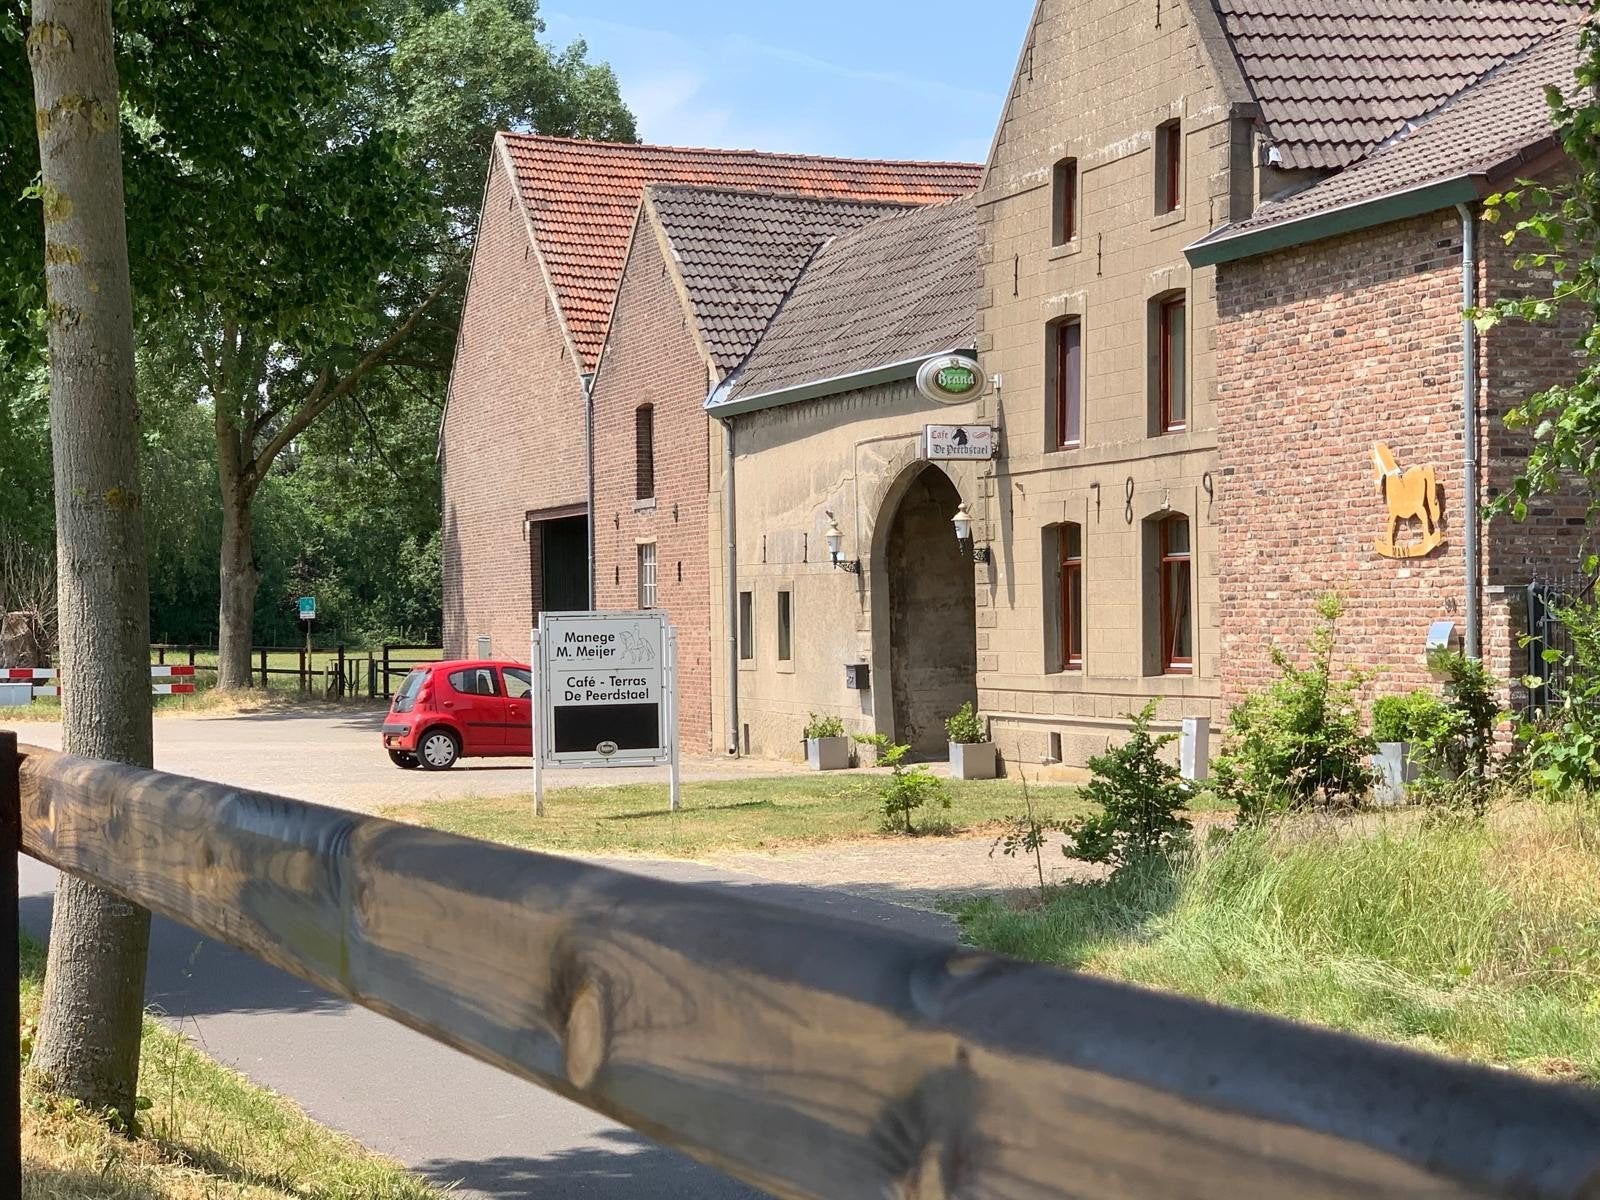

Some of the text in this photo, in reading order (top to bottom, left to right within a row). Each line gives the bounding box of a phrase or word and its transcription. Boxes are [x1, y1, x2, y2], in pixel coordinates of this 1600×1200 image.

[938, 370, 975, 386] Brand
[933, 444, 988, 456] De Peerdstael
[565, 632, 615, 645] Manege
[556, 645, 616, 659] M. Meijer
[566, 676, 596, 688] Café
[609, 675, 647, 687] Terras
[564, 688, 649, 701] De Peerdstael
